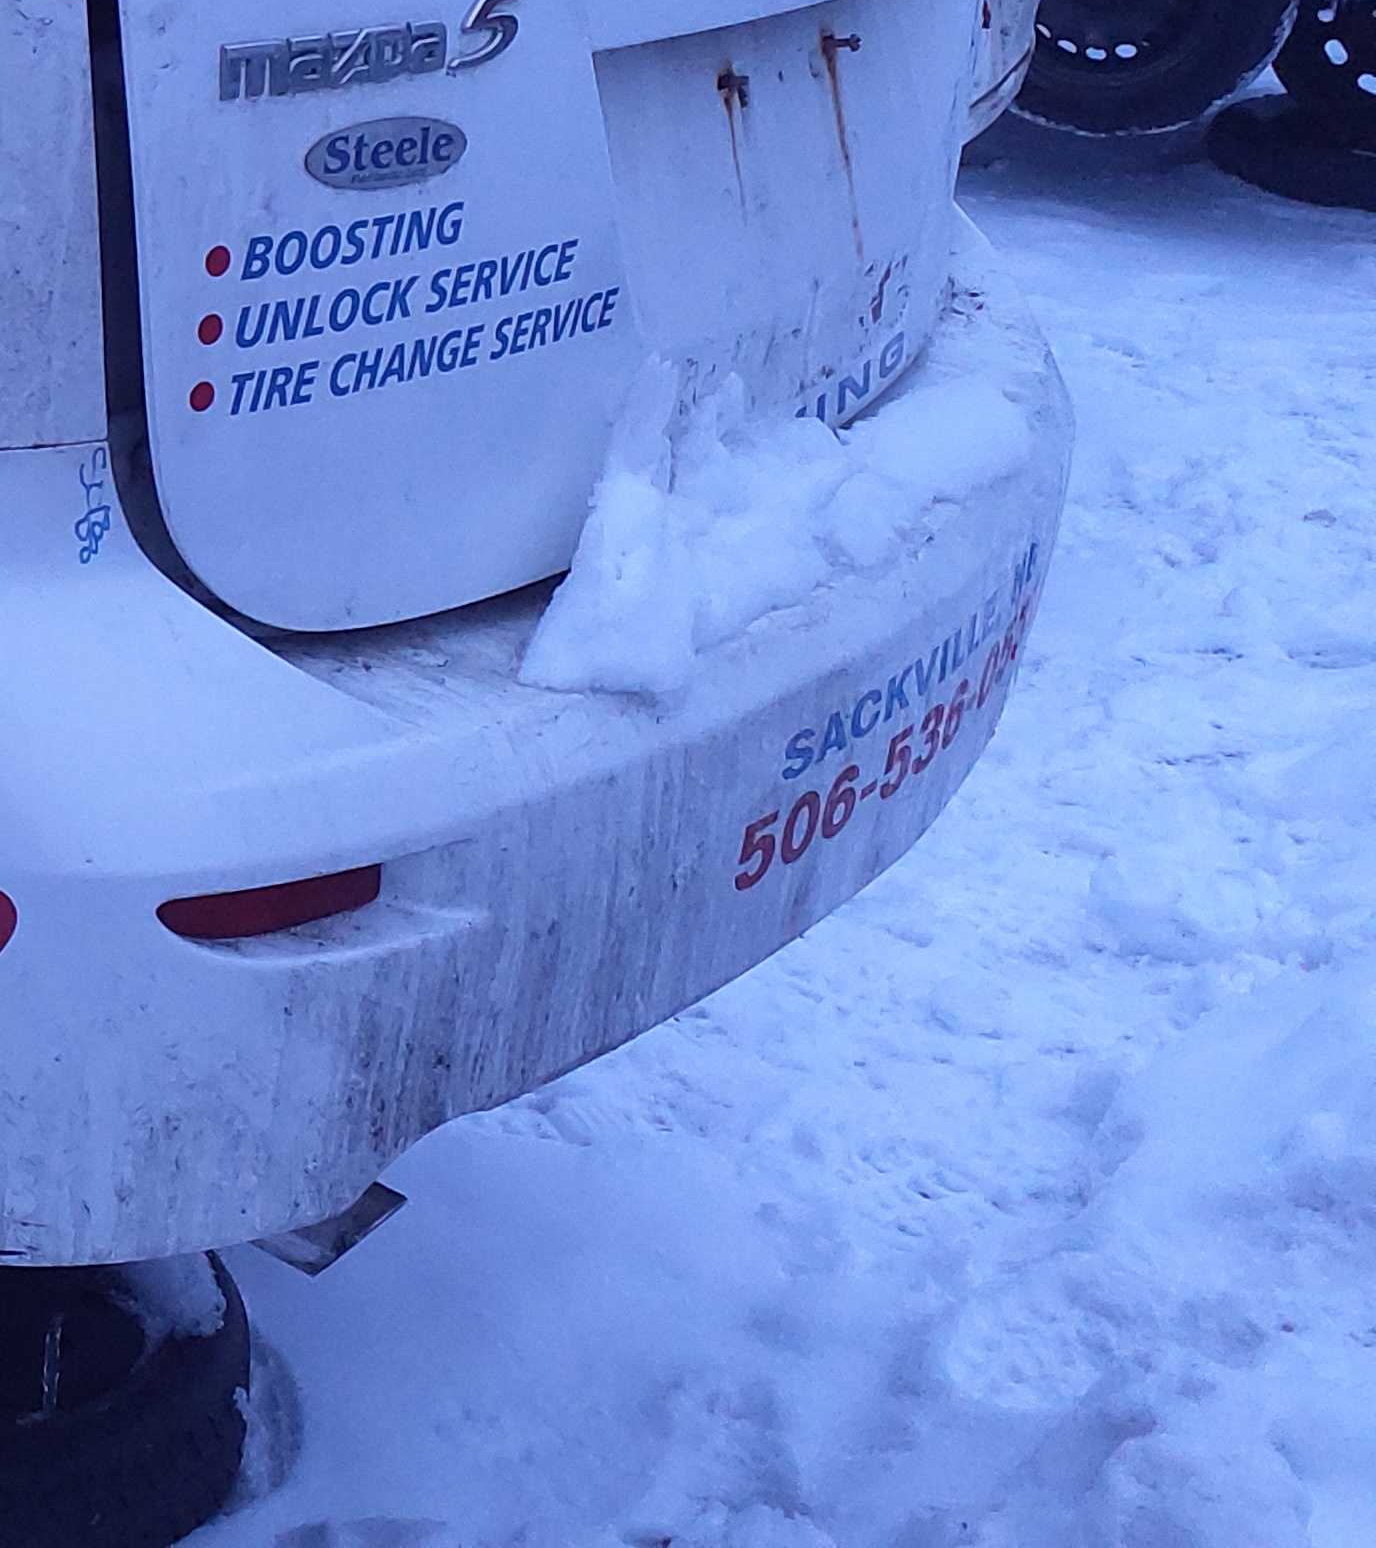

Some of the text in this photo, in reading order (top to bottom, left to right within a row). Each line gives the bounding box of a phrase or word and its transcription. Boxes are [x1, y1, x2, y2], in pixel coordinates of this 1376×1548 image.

[323, 126, 454, 174] Steele
[240, 202, 464, 281] BOOSTING
[235, 239, 578, 348] UNLOCK SERVICE
[229, 288, 619, 416] TIRE CHANGE SERVICE
